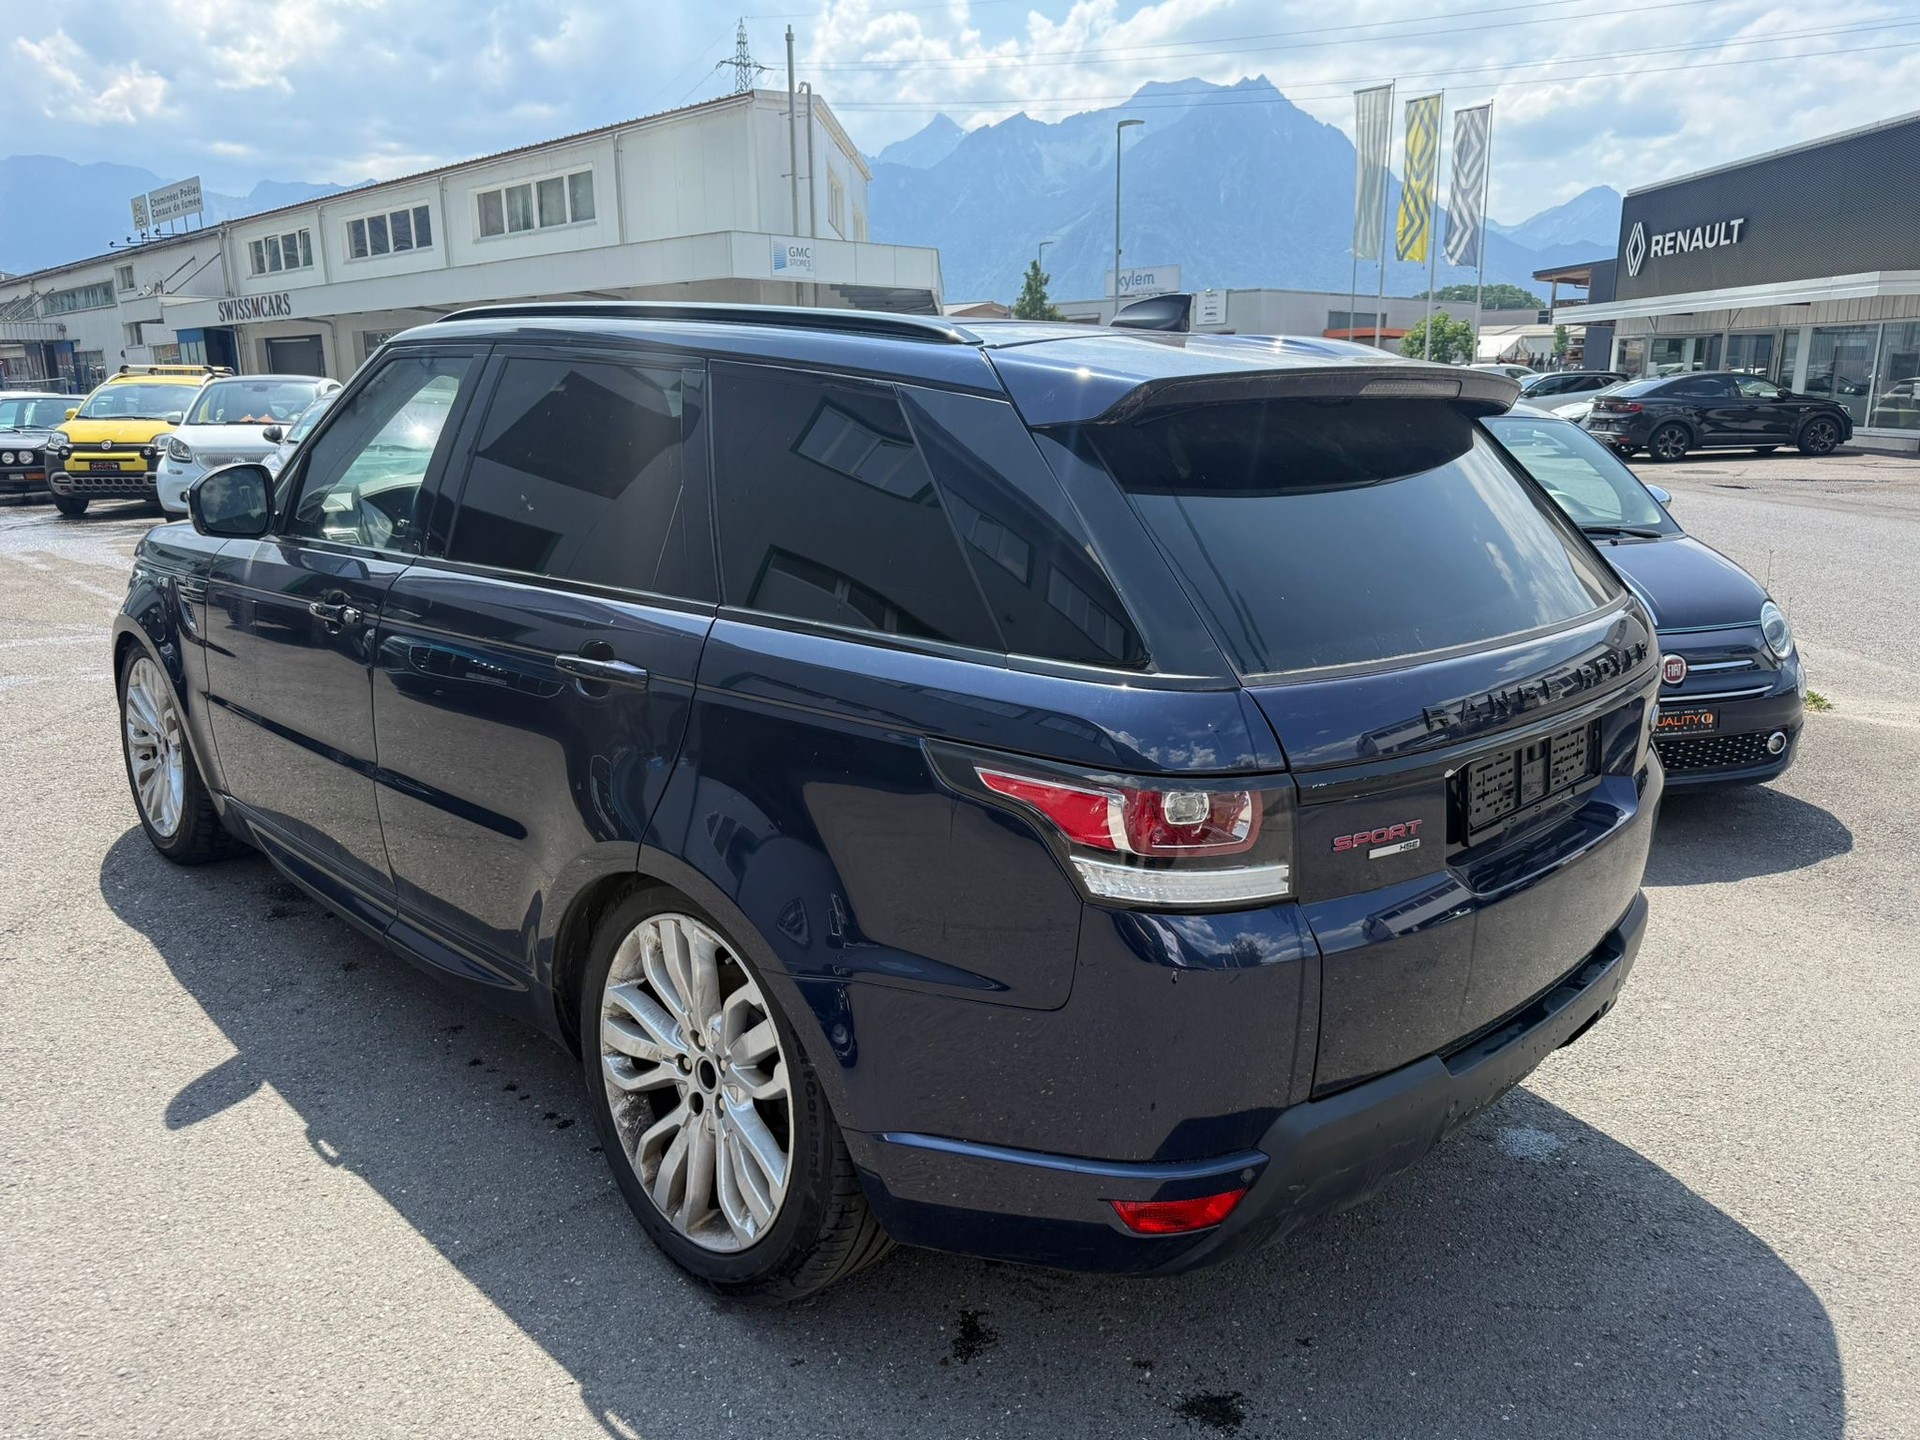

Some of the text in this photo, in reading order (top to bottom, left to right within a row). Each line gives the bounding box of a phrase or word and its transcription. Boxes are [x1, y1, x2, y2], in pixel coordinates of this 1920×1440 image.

[152, 207, 172, 218] Canaux
[173, 202, 180, 212] de
[181, 196, 201, 209] fumée
[1650, 217, 1745, 258] RENAULT
[789, 246, 810, 258] GMC
[218, 293, 291, 322] SWISSMCARS
[1667, 663, 1682, 677] FIAT
[1657, 715, 1700, 726] UALITY
[1333, 819, 1422, 852] SPORT
[1399, 841, 1418, 851] HSE
